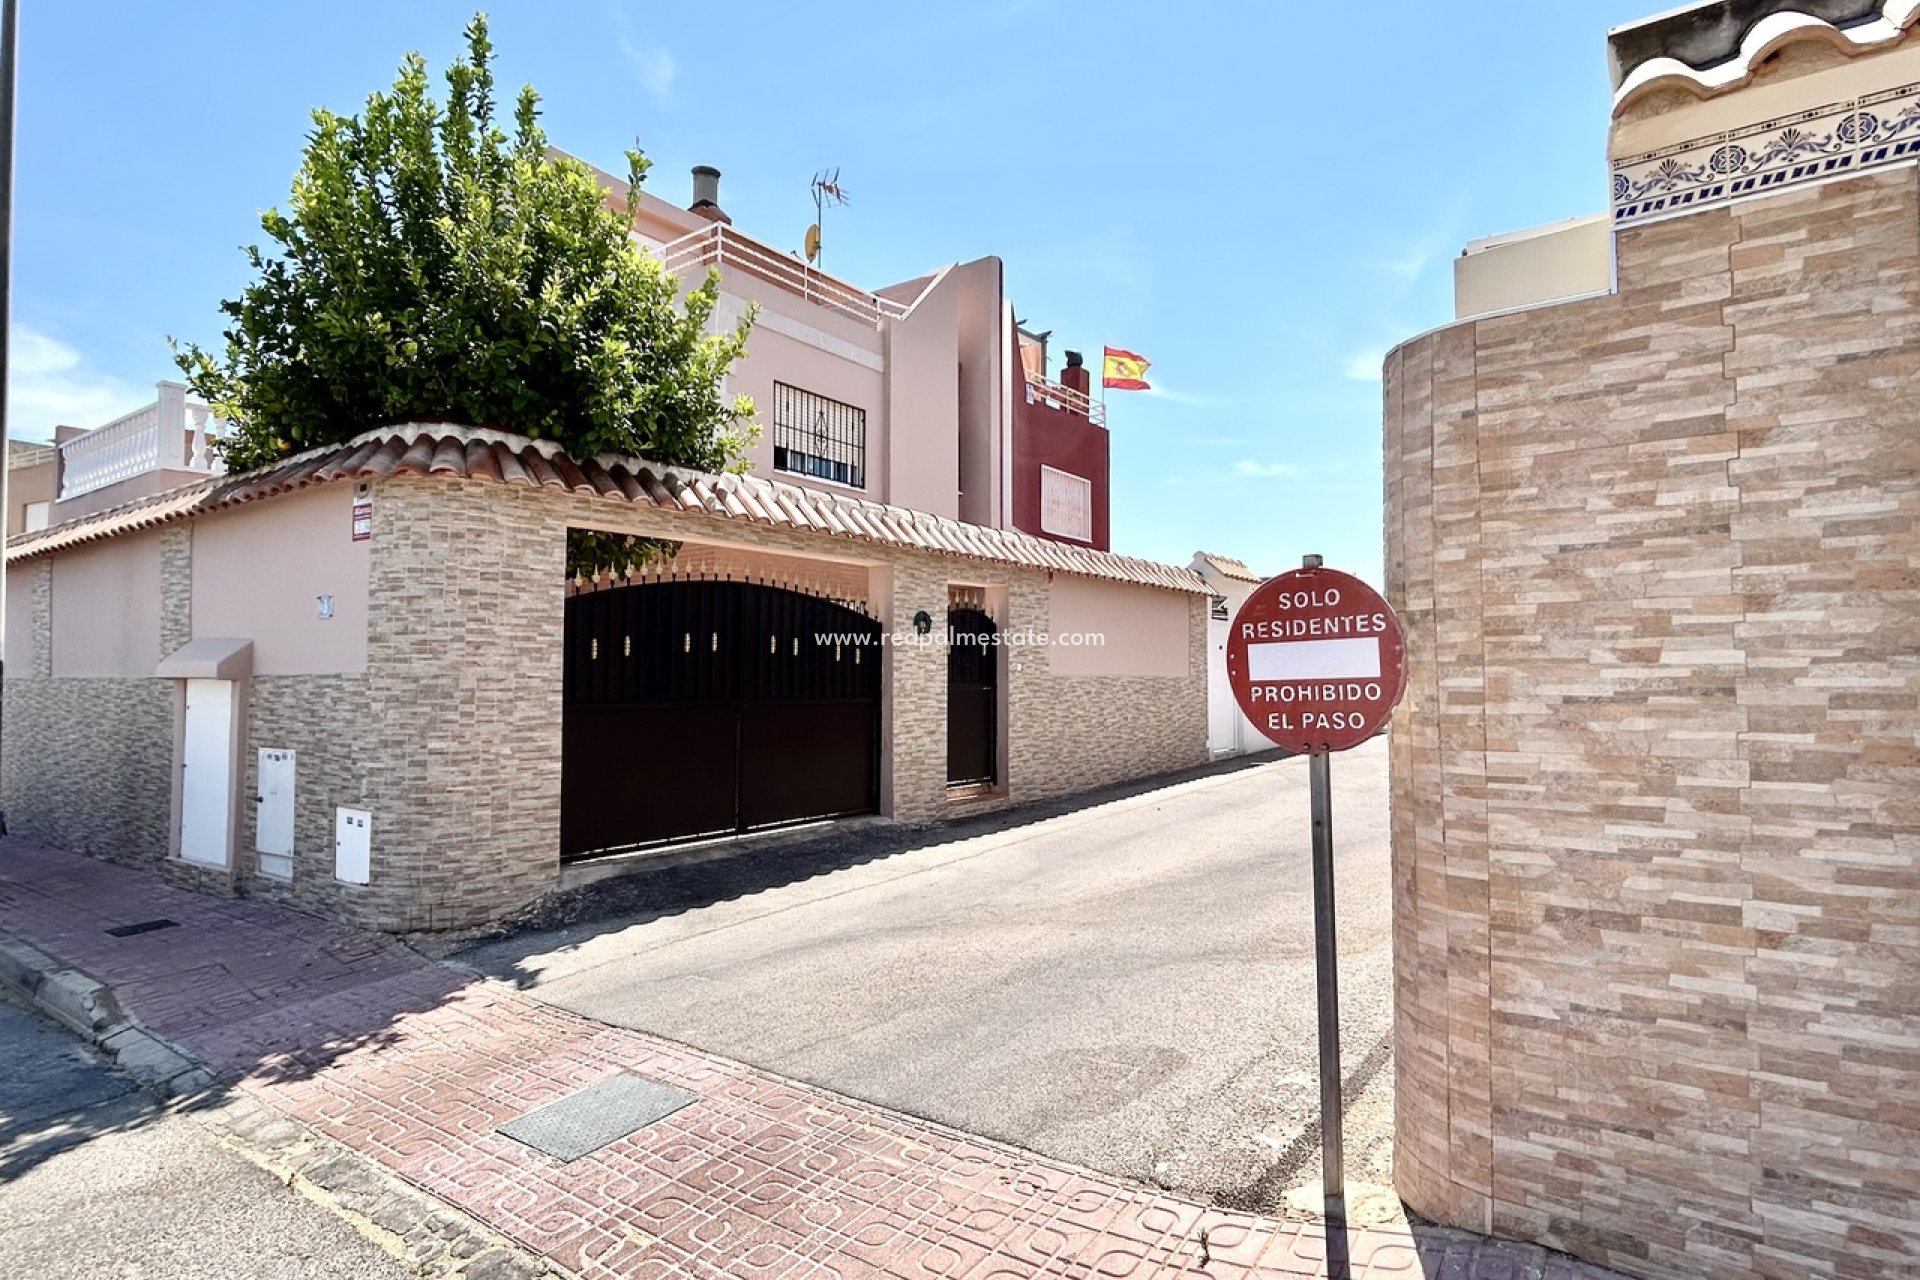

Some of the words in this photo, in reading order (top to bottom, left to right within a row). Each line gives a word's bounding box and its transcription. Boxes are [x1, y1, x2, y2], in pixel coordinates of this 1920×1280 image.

[1278, 588, 1341, 610] SOLO
[1241, 613, 1387, 639] RESIDENTES
[1250, 683, 1382, 702] PROHIBIDO
[1268, 713, 1294, 729] EL
[1302, 712, 1366, 730] PASO
